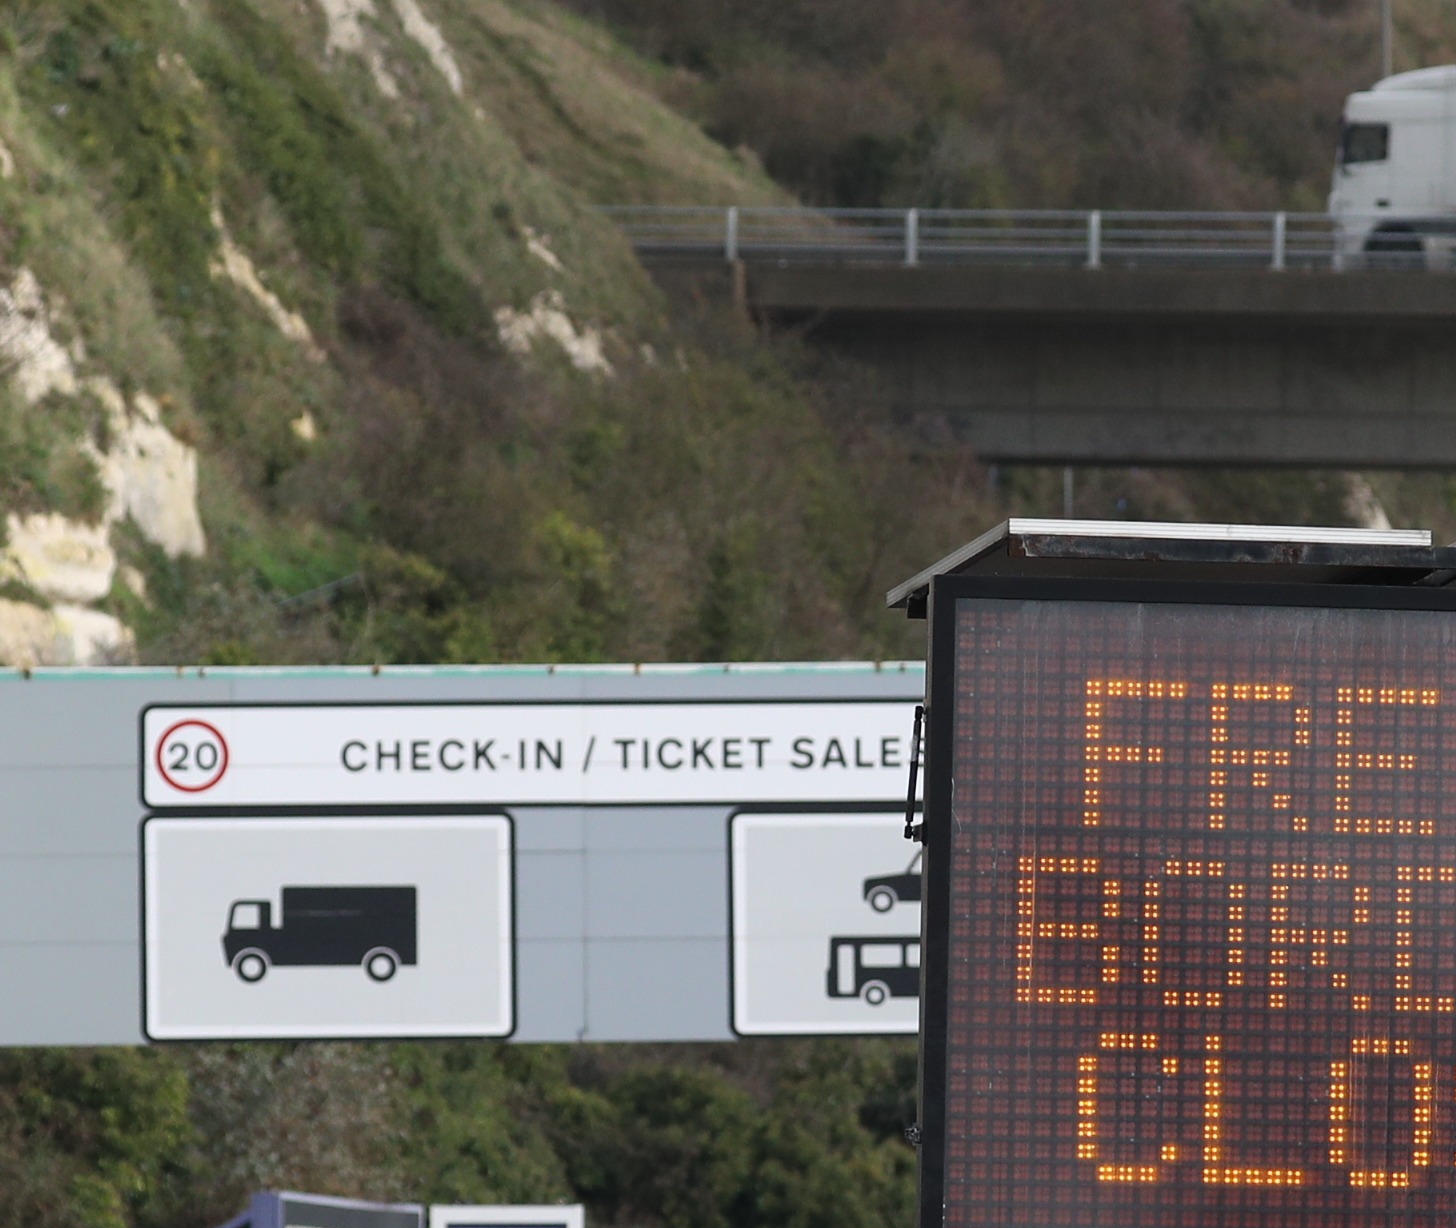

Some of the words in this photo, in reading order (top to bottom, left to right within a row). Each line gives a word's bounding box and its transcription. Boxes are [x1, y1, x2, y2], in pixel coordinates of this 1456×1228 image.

[168, 741, 219, 771] 20
[341, 739, 563, 771] CHECK-IN
[582, 736, 596, 774] /
[613, 738, 772, 769] TICKET
